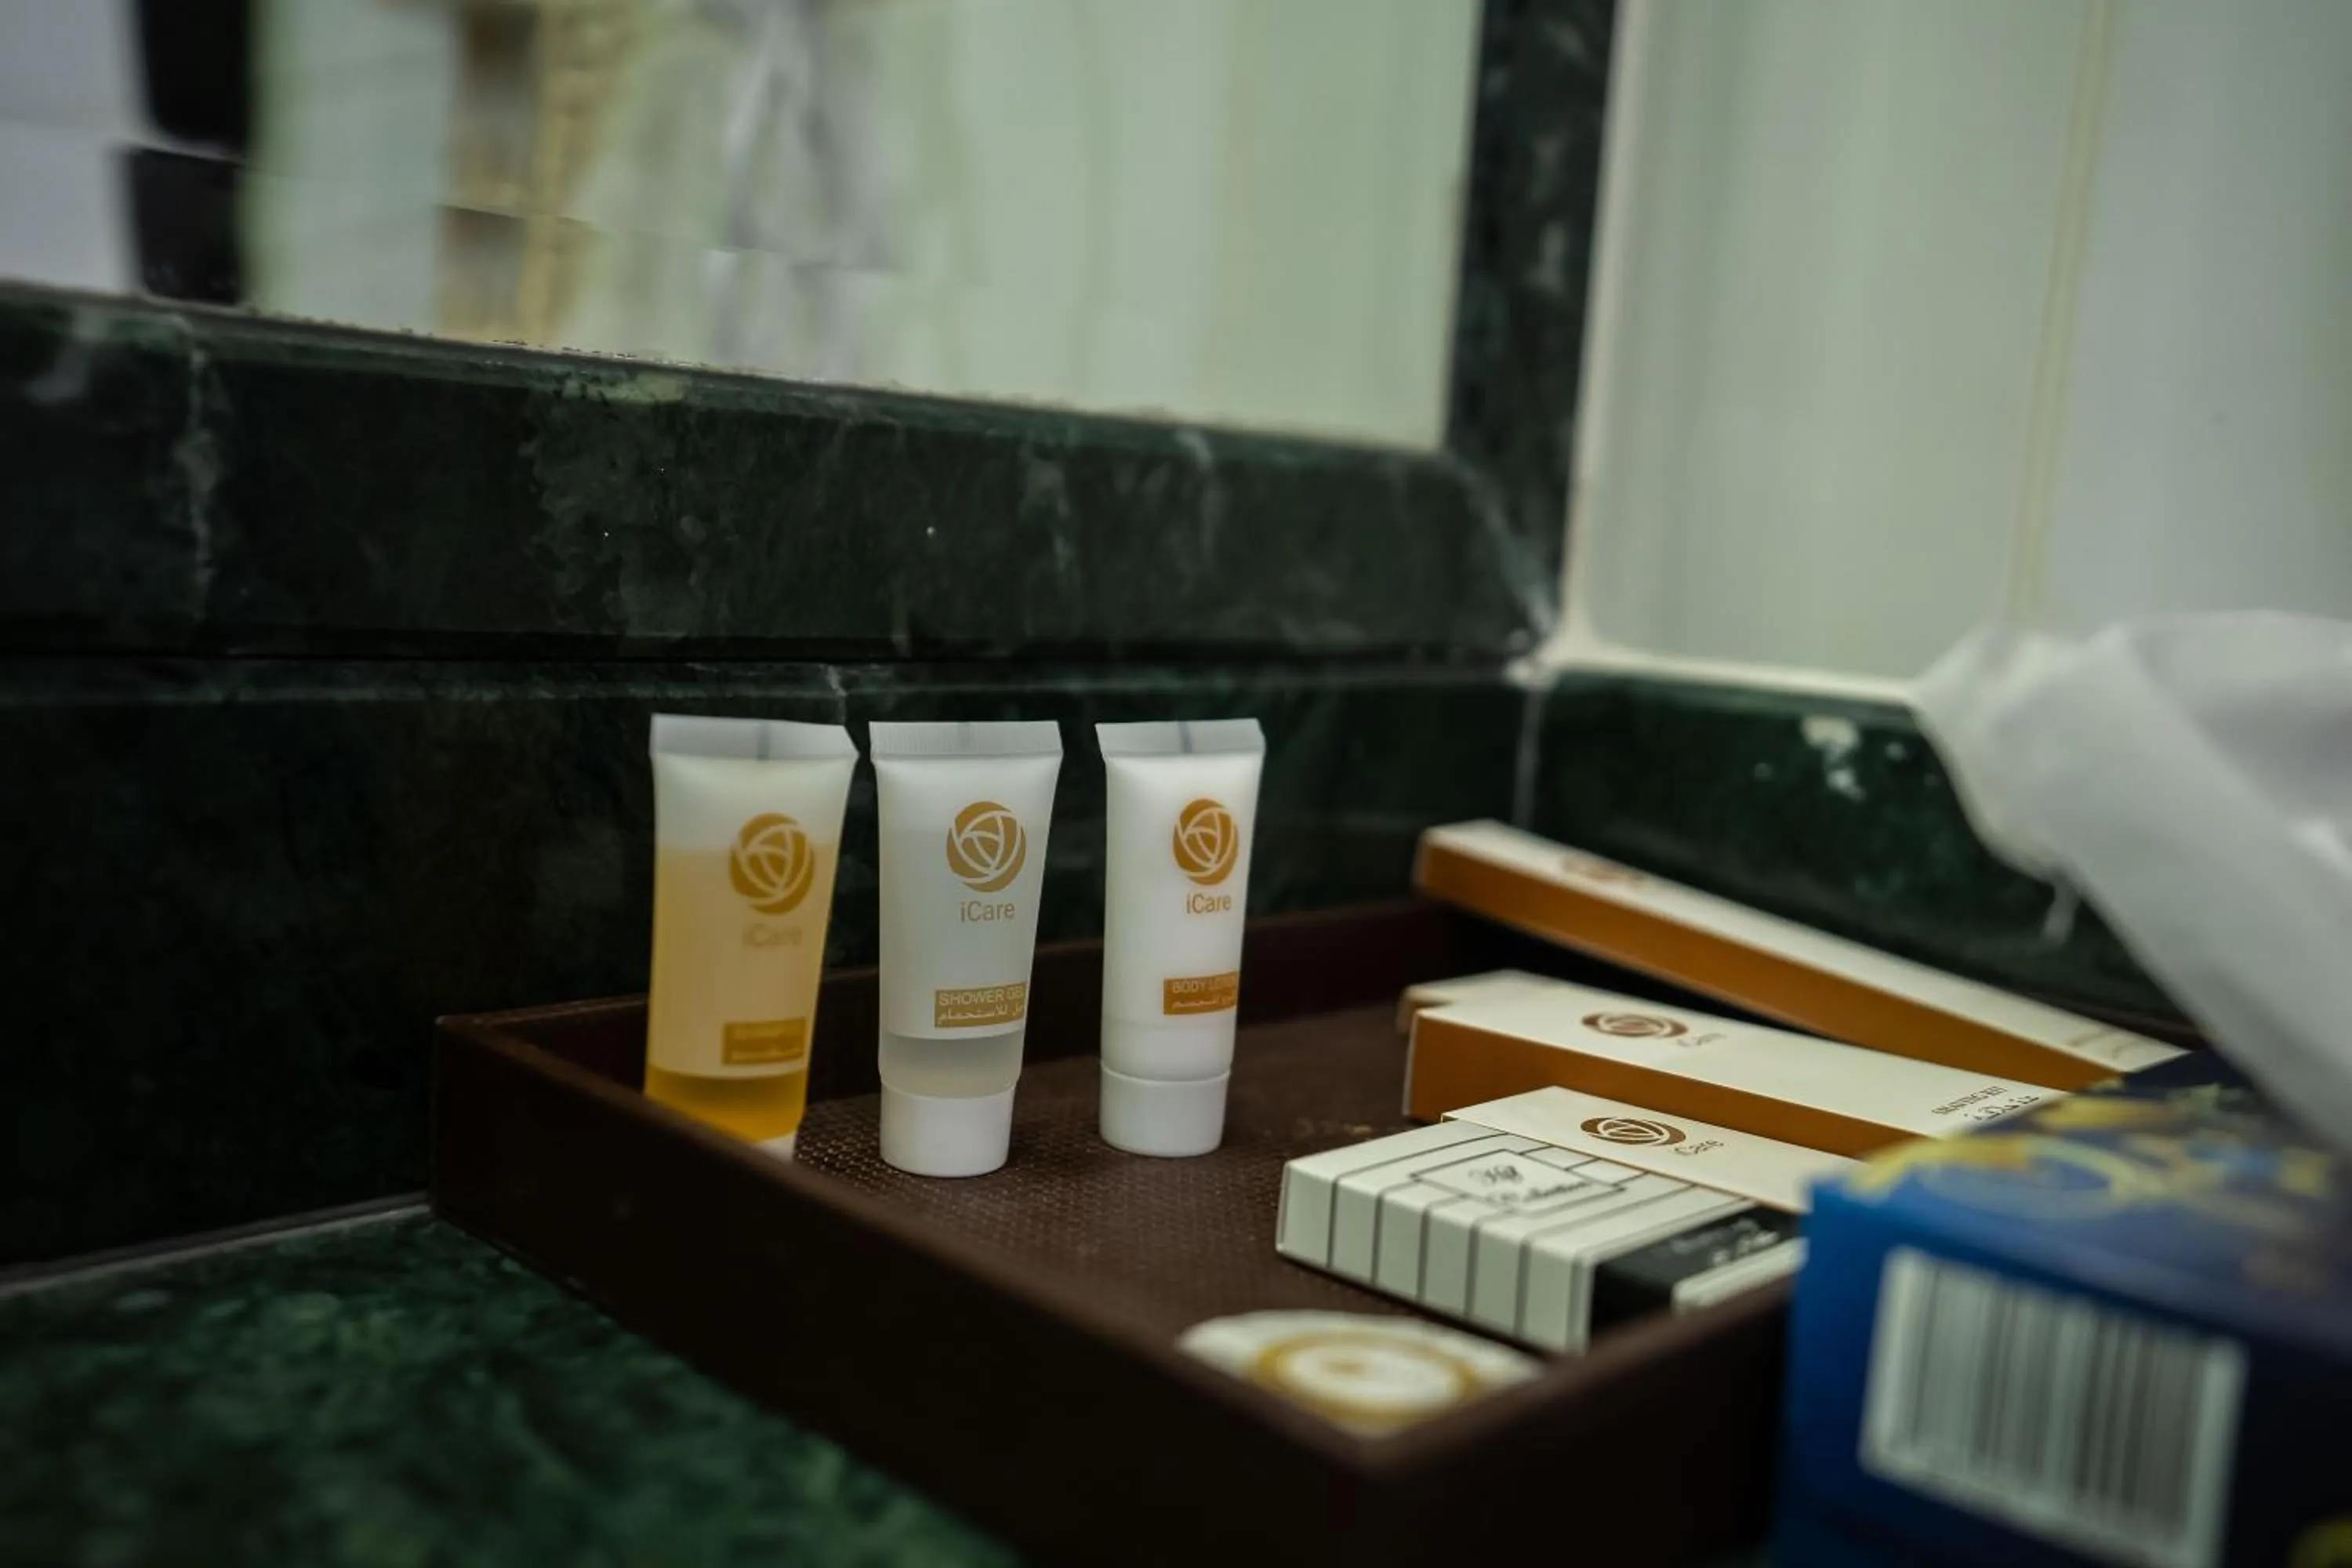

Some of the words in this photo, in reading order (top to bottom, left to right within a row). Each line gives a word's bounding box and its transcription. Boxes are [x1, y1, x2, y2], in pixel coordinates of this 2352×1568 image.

[960, 901, 1016, 923] iCare
[1185, 893, 1232, 914] iCare
[939, 989, 1004, 1006] SHOWER
